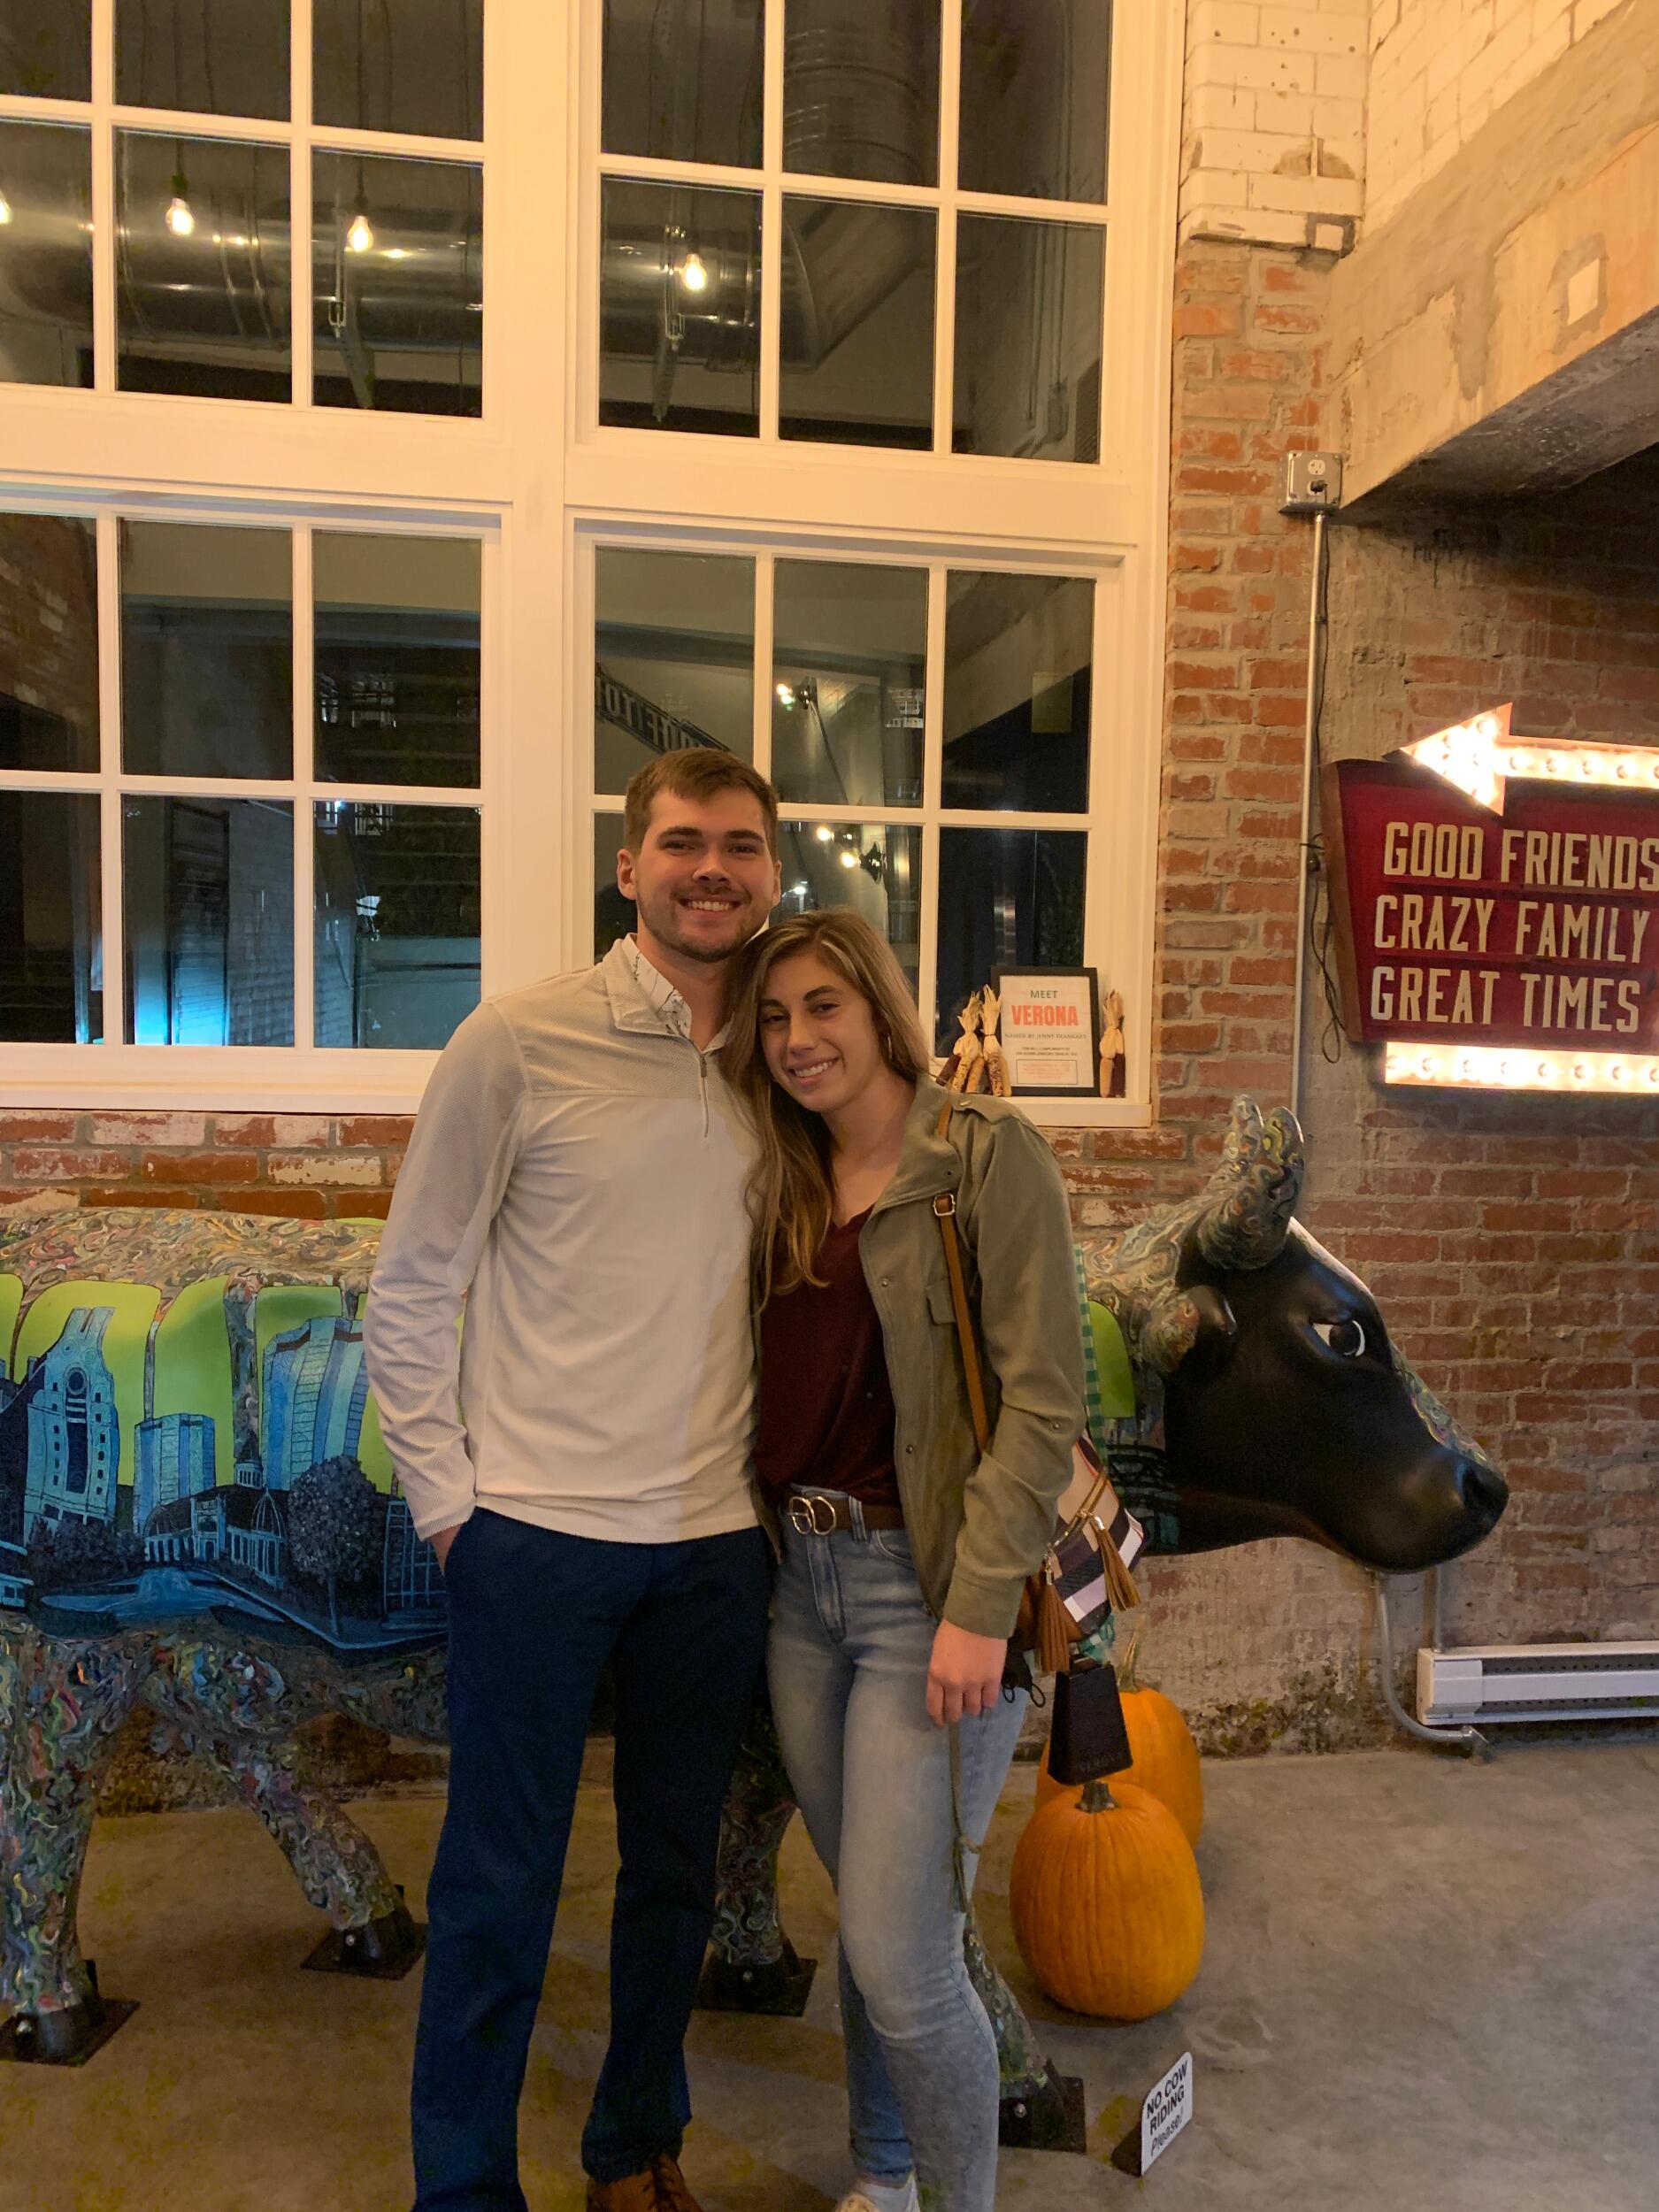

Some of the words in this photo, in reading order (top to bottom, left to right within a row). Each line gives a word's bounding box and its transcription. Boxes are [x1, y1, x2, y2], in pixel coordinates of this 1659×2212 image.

[1383, 821, 1485, 880] GOOD
[1501, 829, 1659, 892] FRIENDS
[1374, 894, 1495, 953] CRAZY
[1516, 902, 1650, 964] FAMILY
[1011, 1004, 1079, 1026] VERONA
[1030, 990, 1058, 999] MEET
[1371, 966, 1500, 1025] GREAT
[1520, 973, 1640, 1033] TIMES
[1147, 2091, 1162, 2119] NO
[1164, 2060, 1187, 2095] COW
[1150, 2085, 1185, 2136] RIDING
